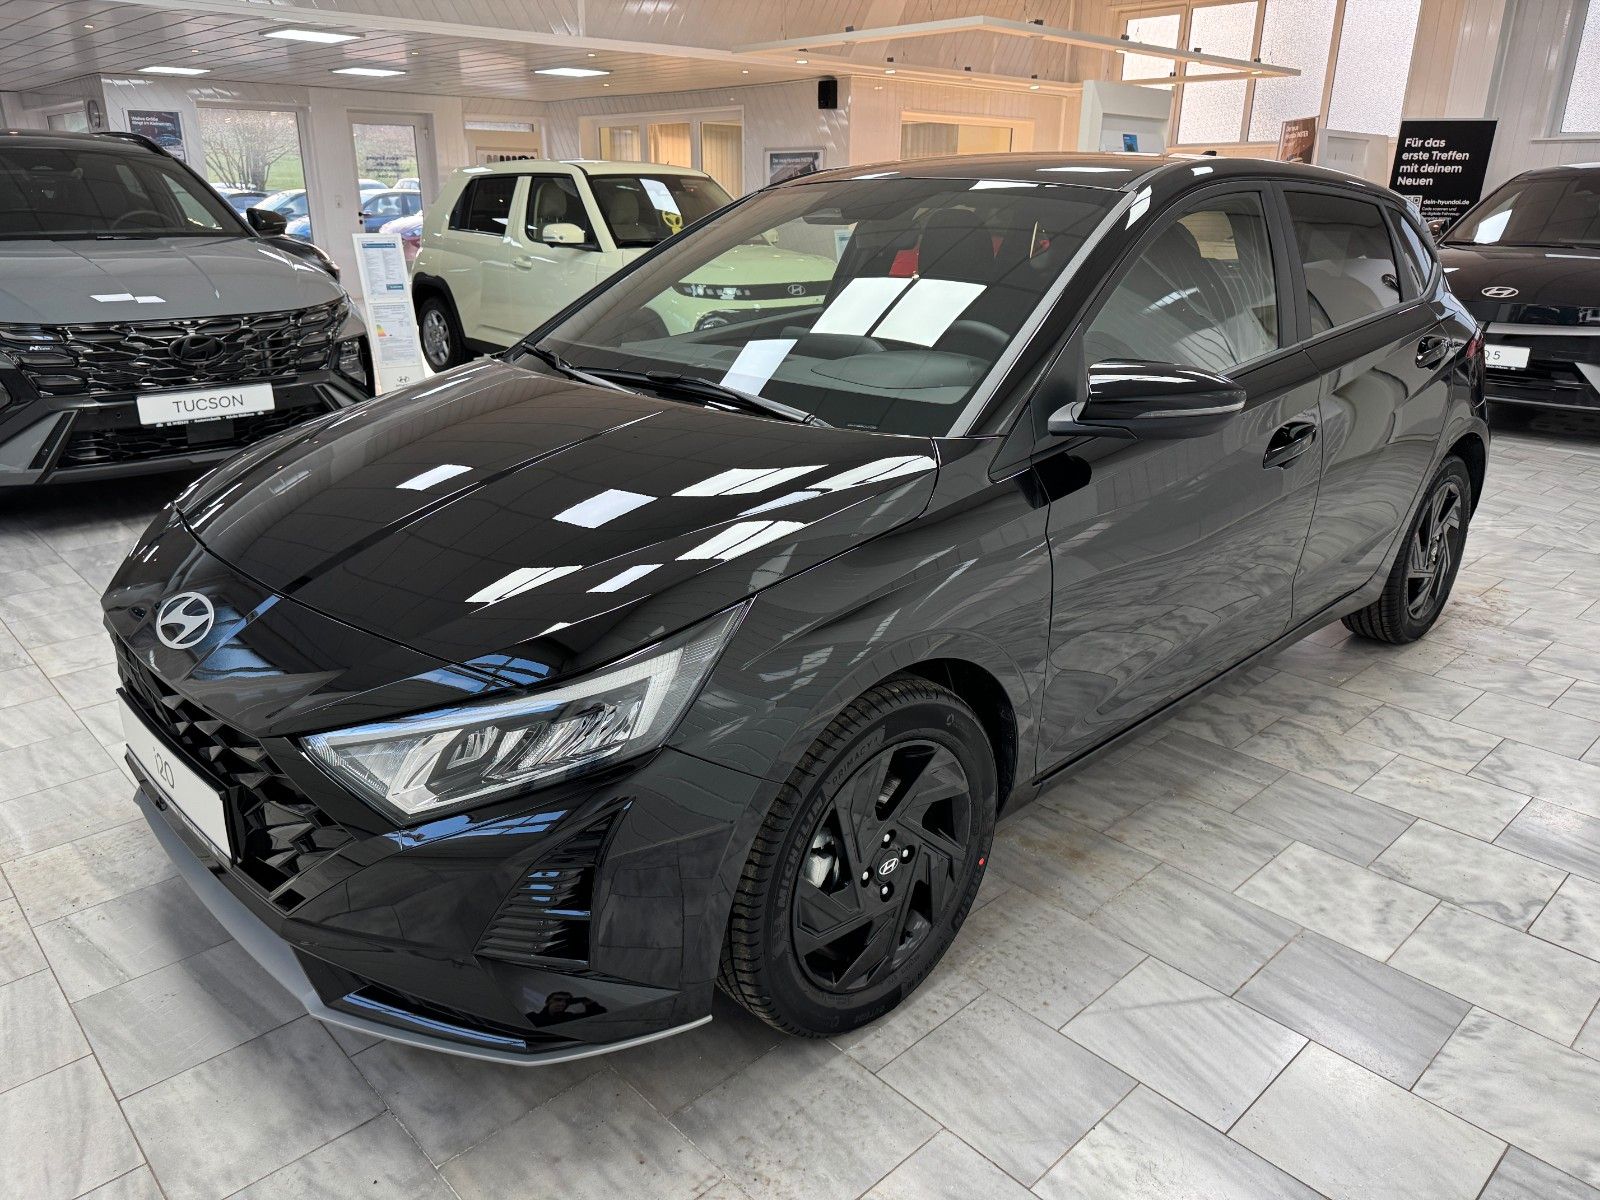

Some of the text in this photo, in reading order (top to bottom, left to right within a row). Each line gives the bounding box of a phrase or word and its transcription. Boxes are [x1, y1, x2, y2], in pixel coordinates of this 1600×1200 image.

[1404, 137, 1446, 148] Für das
[1401, 150, 1470, 161] erste Treffen
[1399, 163, 1463, 173] mit deinem
[1396, 176, 1434, 186] Neuen
[1492, 350, 1501, 361] 5
[172, 394, 244, 413] TUCSON
[152, 746, 175, 789] i20
